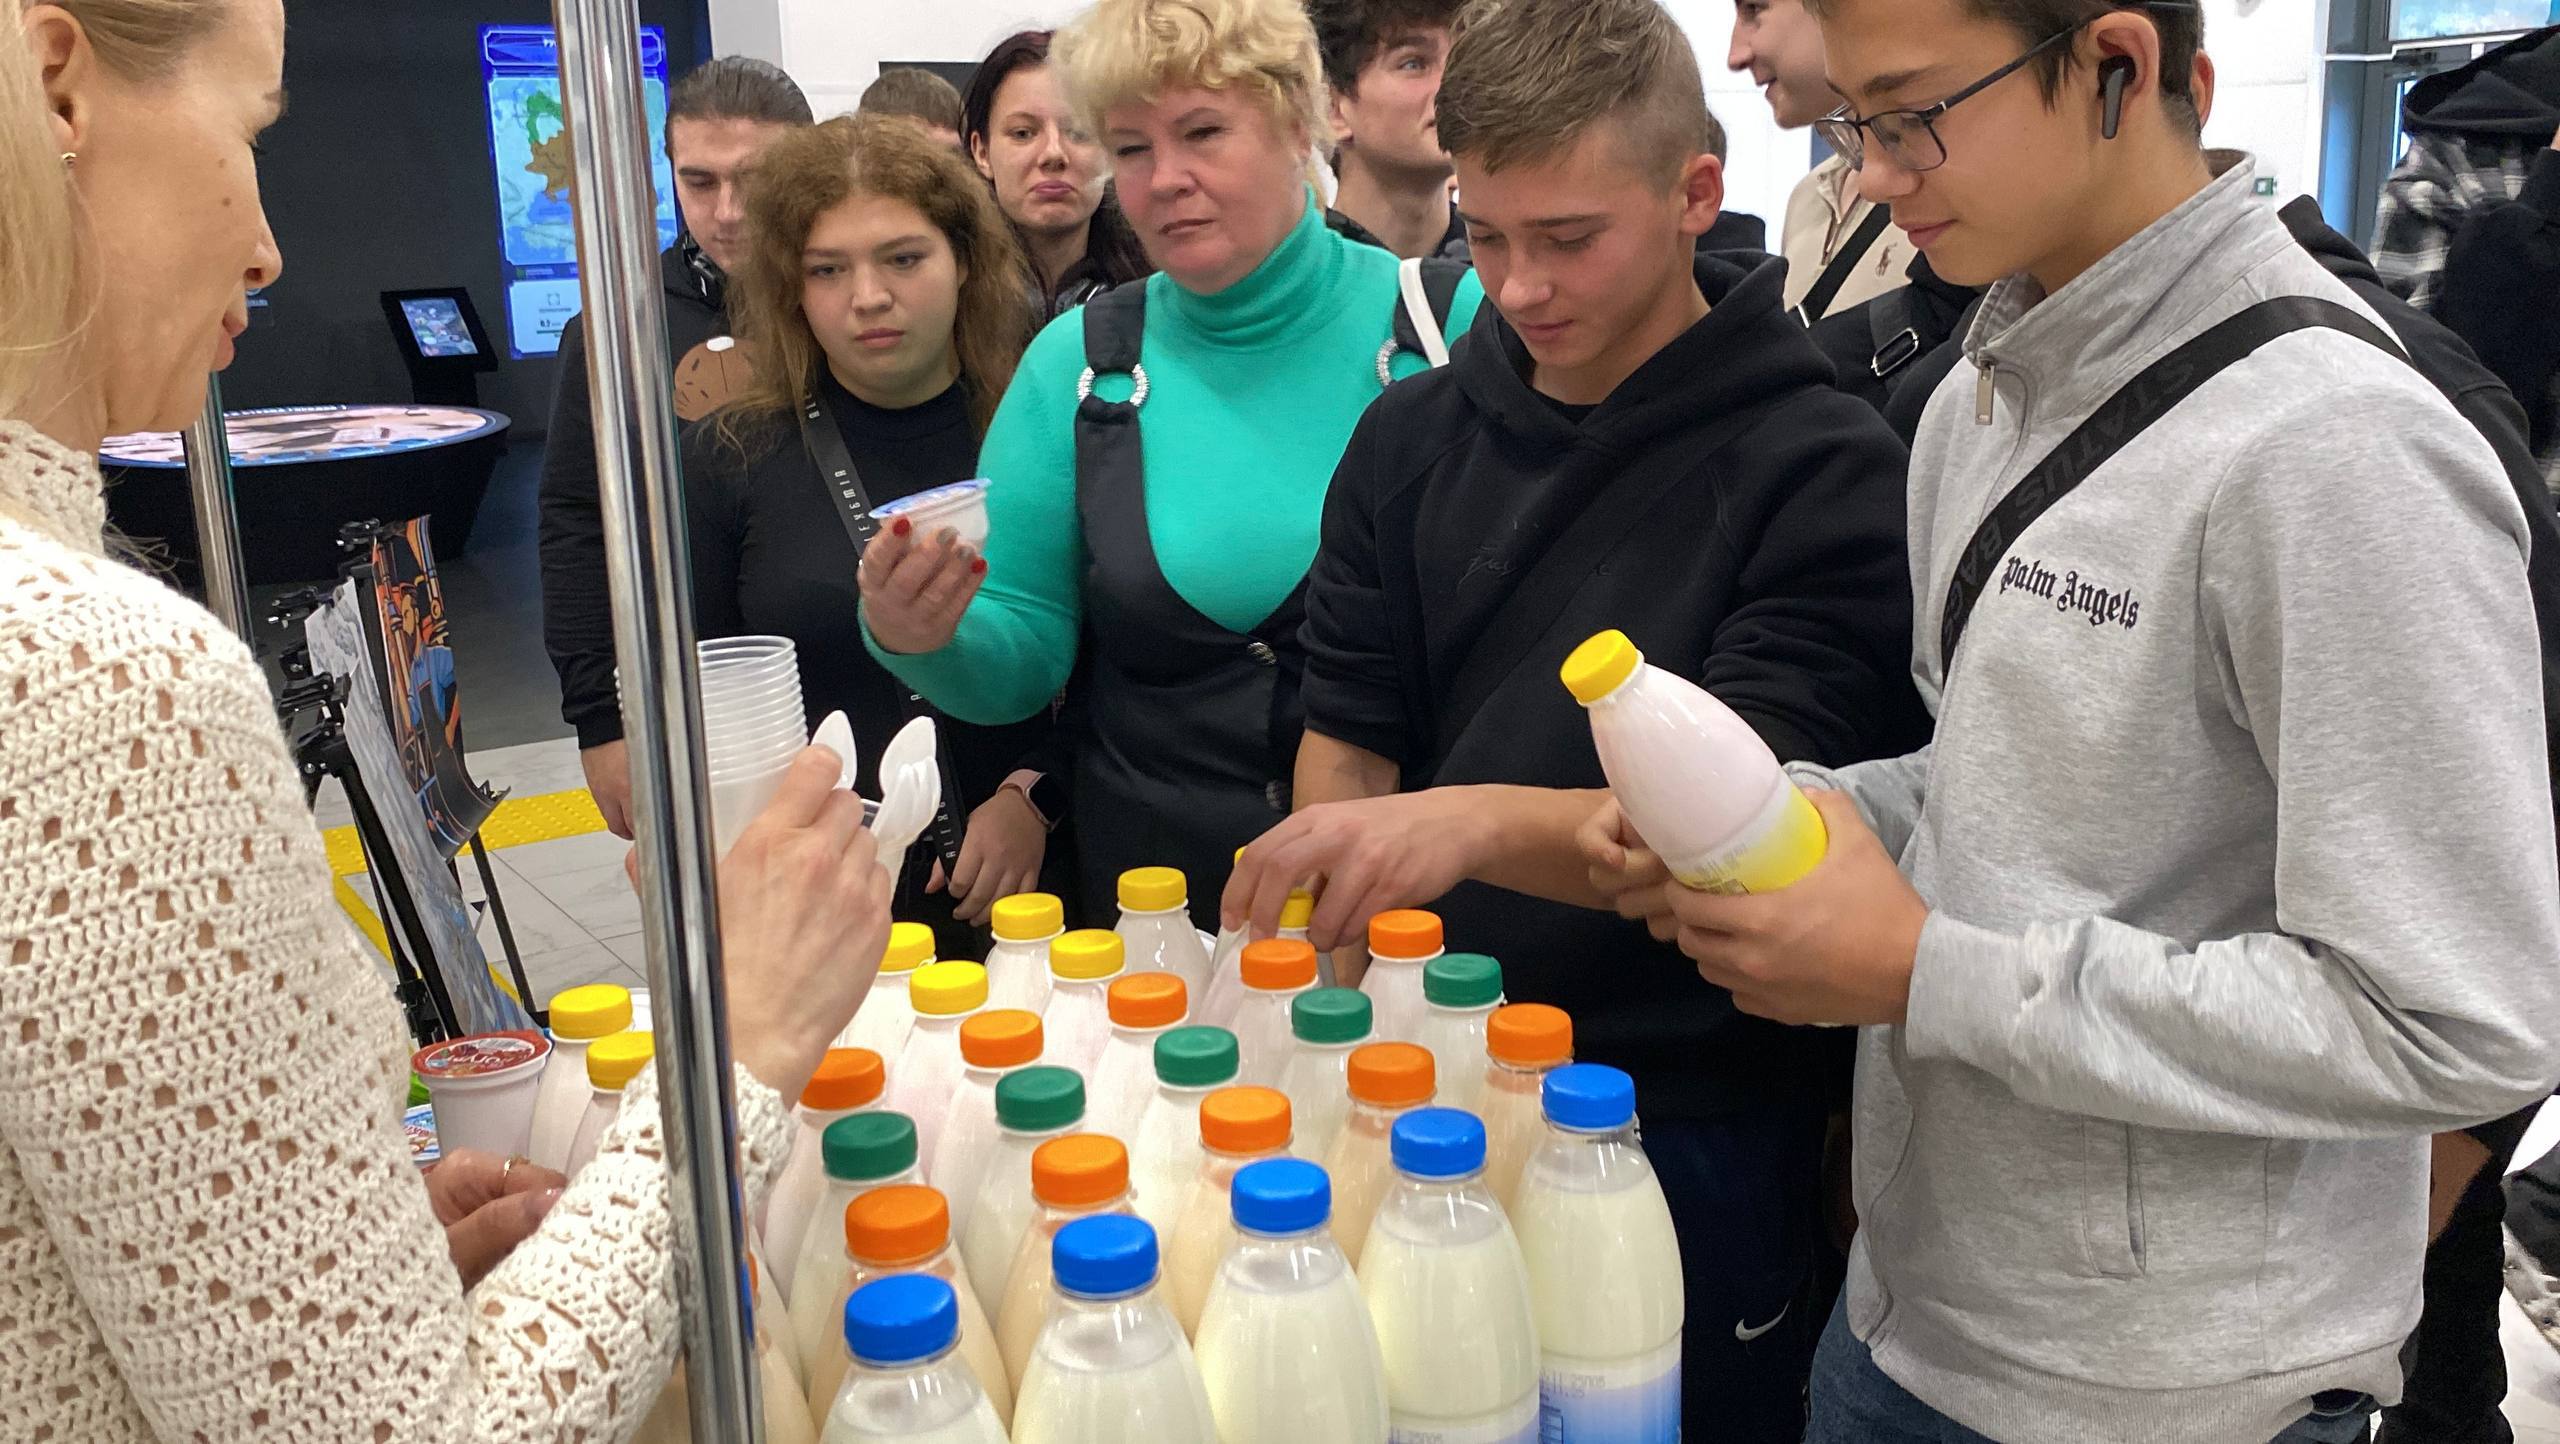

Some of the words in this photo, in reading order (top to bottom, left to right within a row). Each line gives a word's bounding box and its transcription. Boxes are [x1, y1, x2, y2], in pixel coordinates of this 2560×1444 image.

[2015, 360, 2194, 520] STATUS
[2000, 556, 2057, 600] Palm
[2057, 570, 2139, 629] Angels
